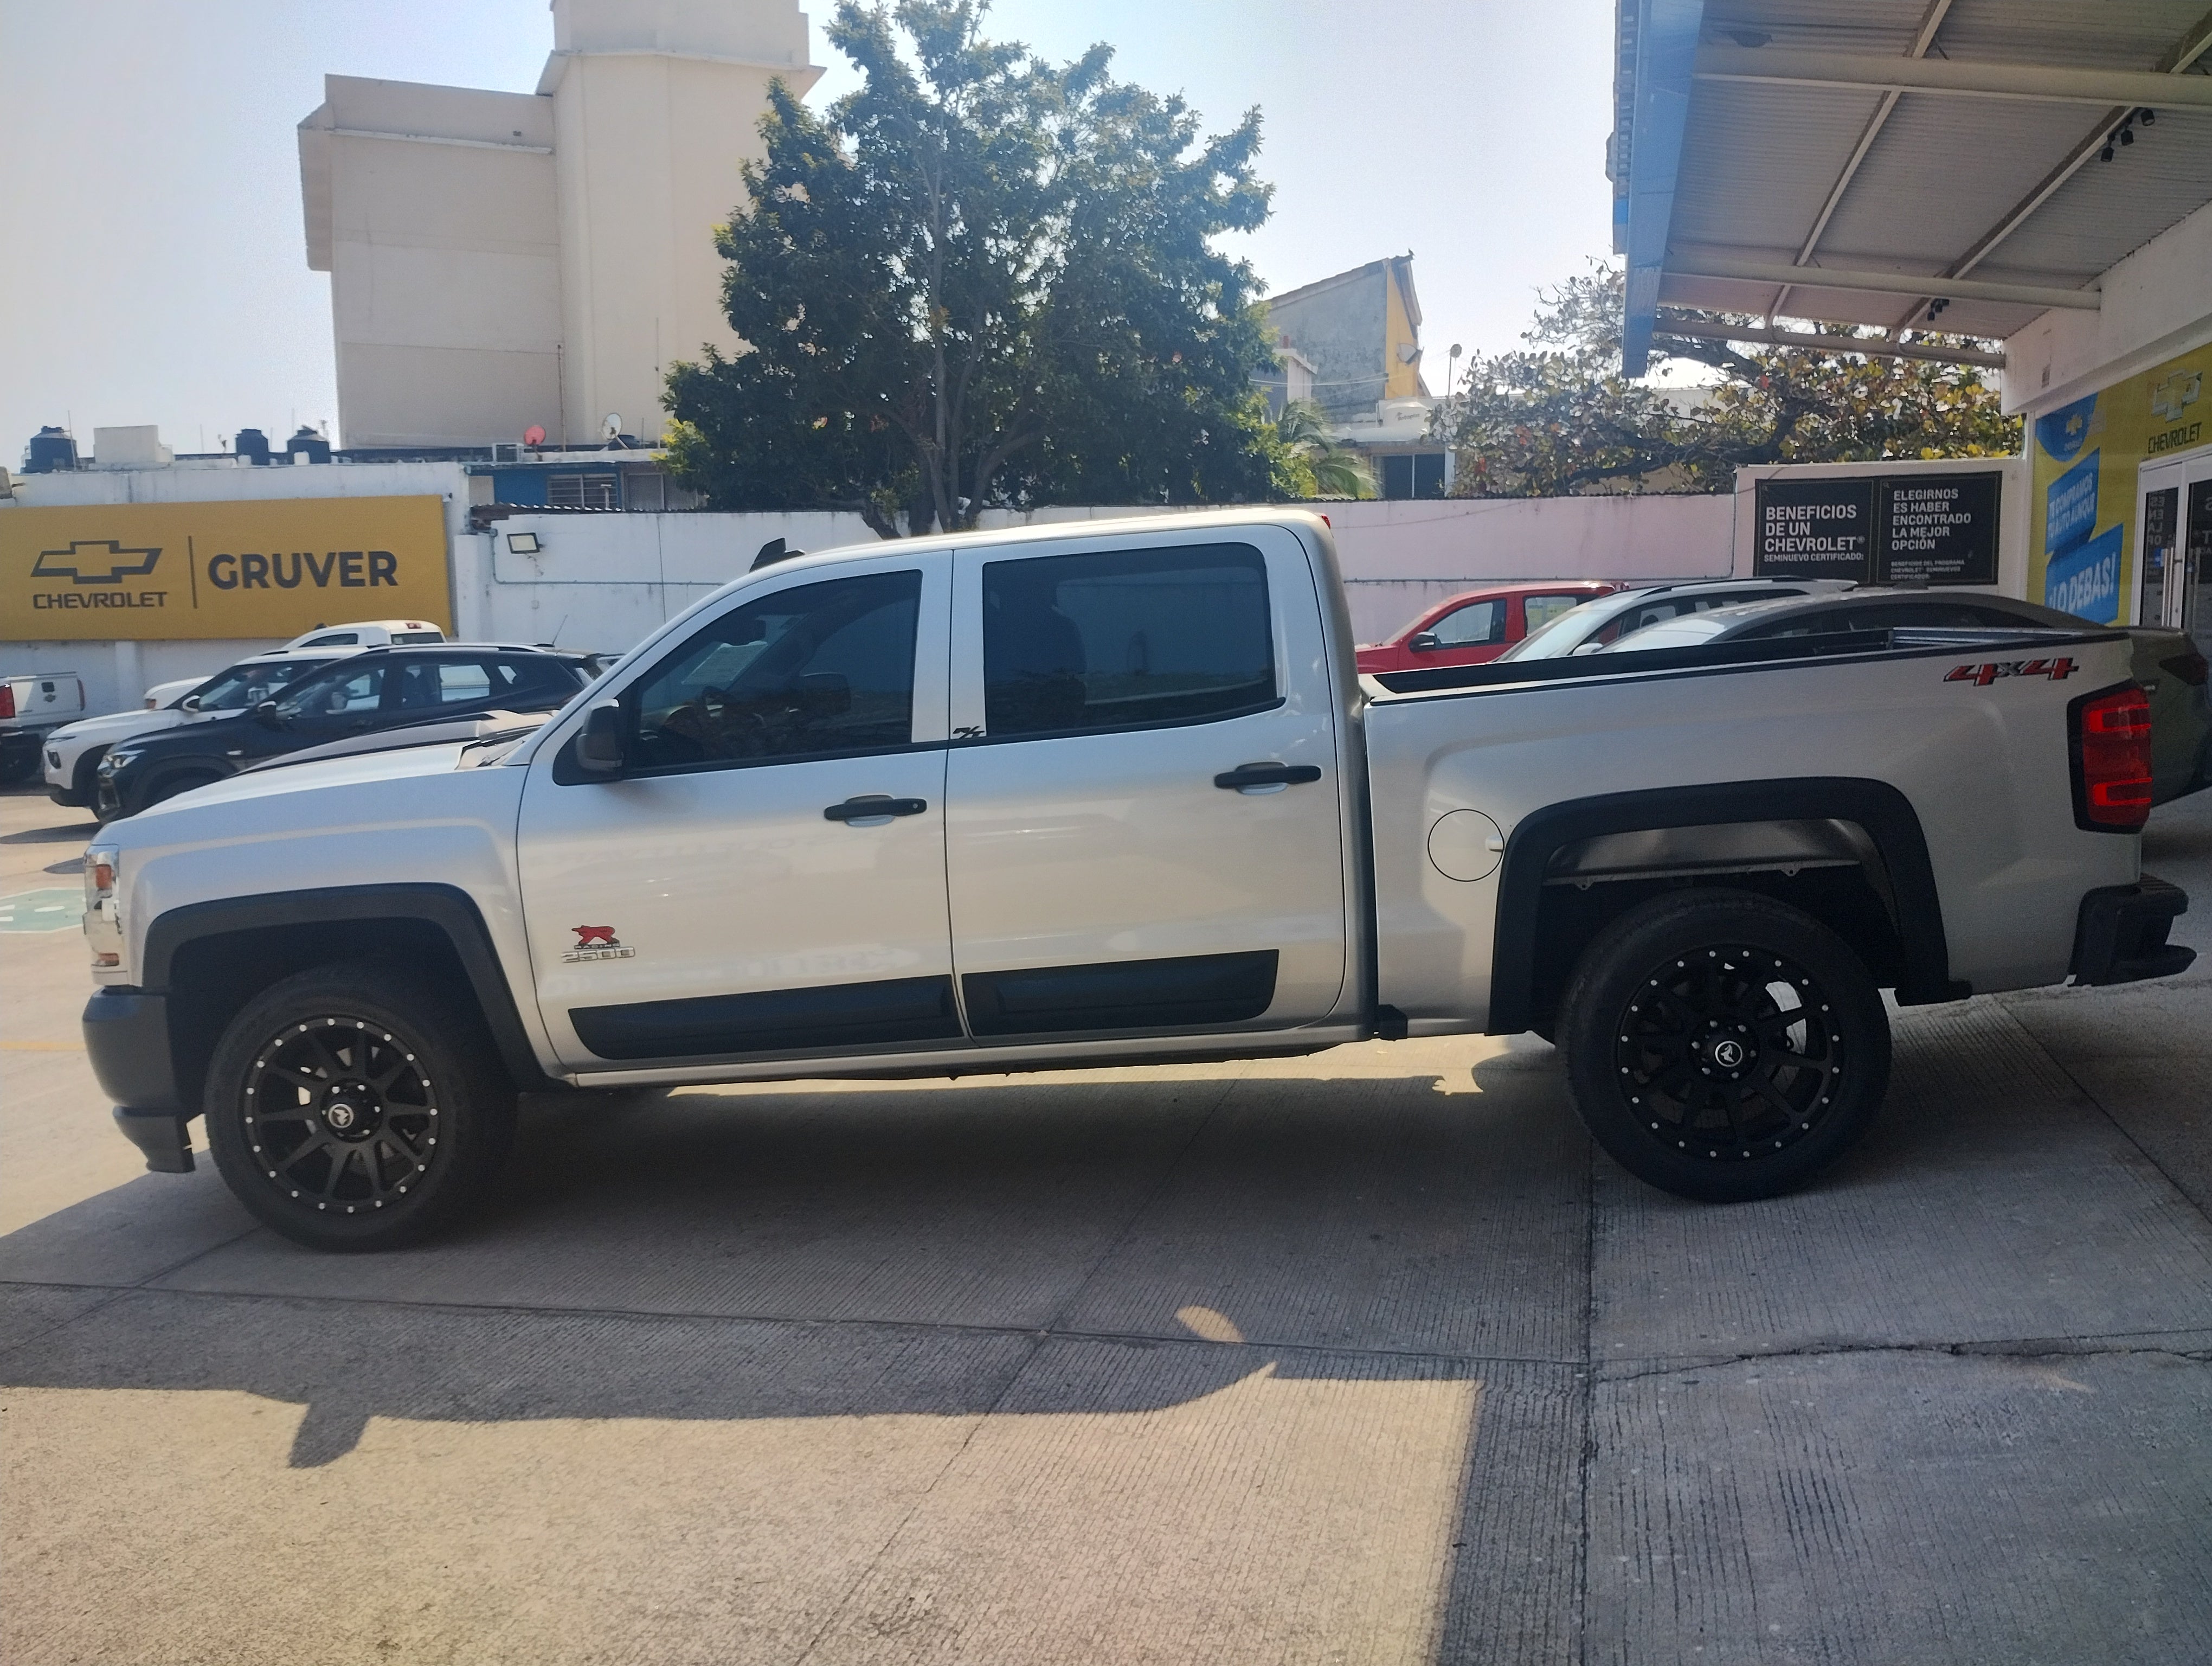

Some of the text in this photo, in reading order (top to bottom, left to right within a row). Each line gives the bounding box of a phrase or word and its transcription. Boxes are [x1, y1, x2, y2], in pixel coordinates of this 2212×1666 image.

[2148, 421, 2202, 454] CHEVROLET
[1894, 489, 1959, 501] ELEGIRNOS
[1766, 504, 1857, 521] BENEFICIOS
[1893, 501, 1950, 514] ES HABER
[1893, 513, 1971, 526] ENCONTRADO
[1765, 522, 1810, 536] DE UN
[1892, 526, 1950, 538] LA MEJOR
[1892, 537, 1935, 550] OPCIÓN
[1764, 553, 1809, 562] SEMINUEVO
[208, 551, 399, 590] GRUVER
[2068, 551, 2116, 614] DEBAS!
[33, 592, 168, 609] CHEVROLET
[561, 946, 635, 963] 2500
